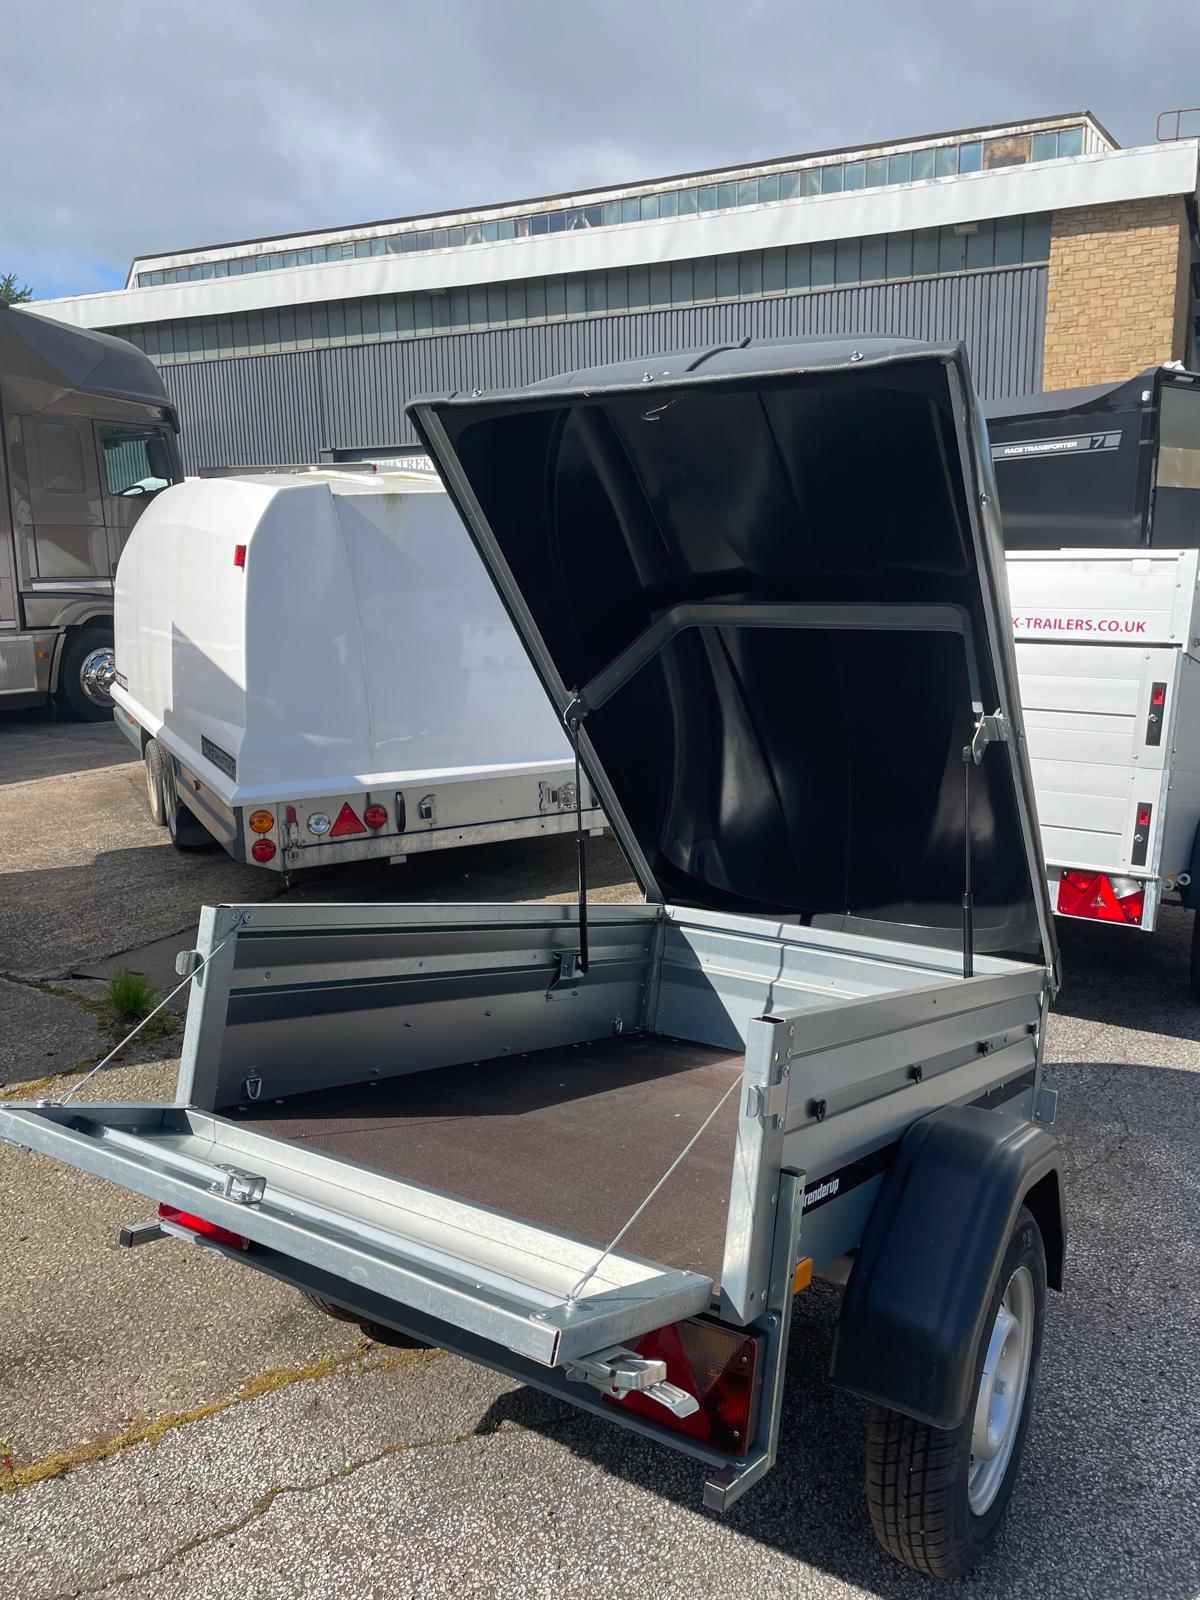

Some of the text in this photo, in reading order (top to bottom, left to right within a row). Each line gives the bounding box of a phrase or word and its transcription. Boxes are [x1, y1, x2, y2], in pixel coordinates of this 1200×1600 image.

[1024, 441, 1078, 452] TRANSPORTER
[1092, 436, 1104, 448] 7
[803, 1178, 839, 1207] renderup
